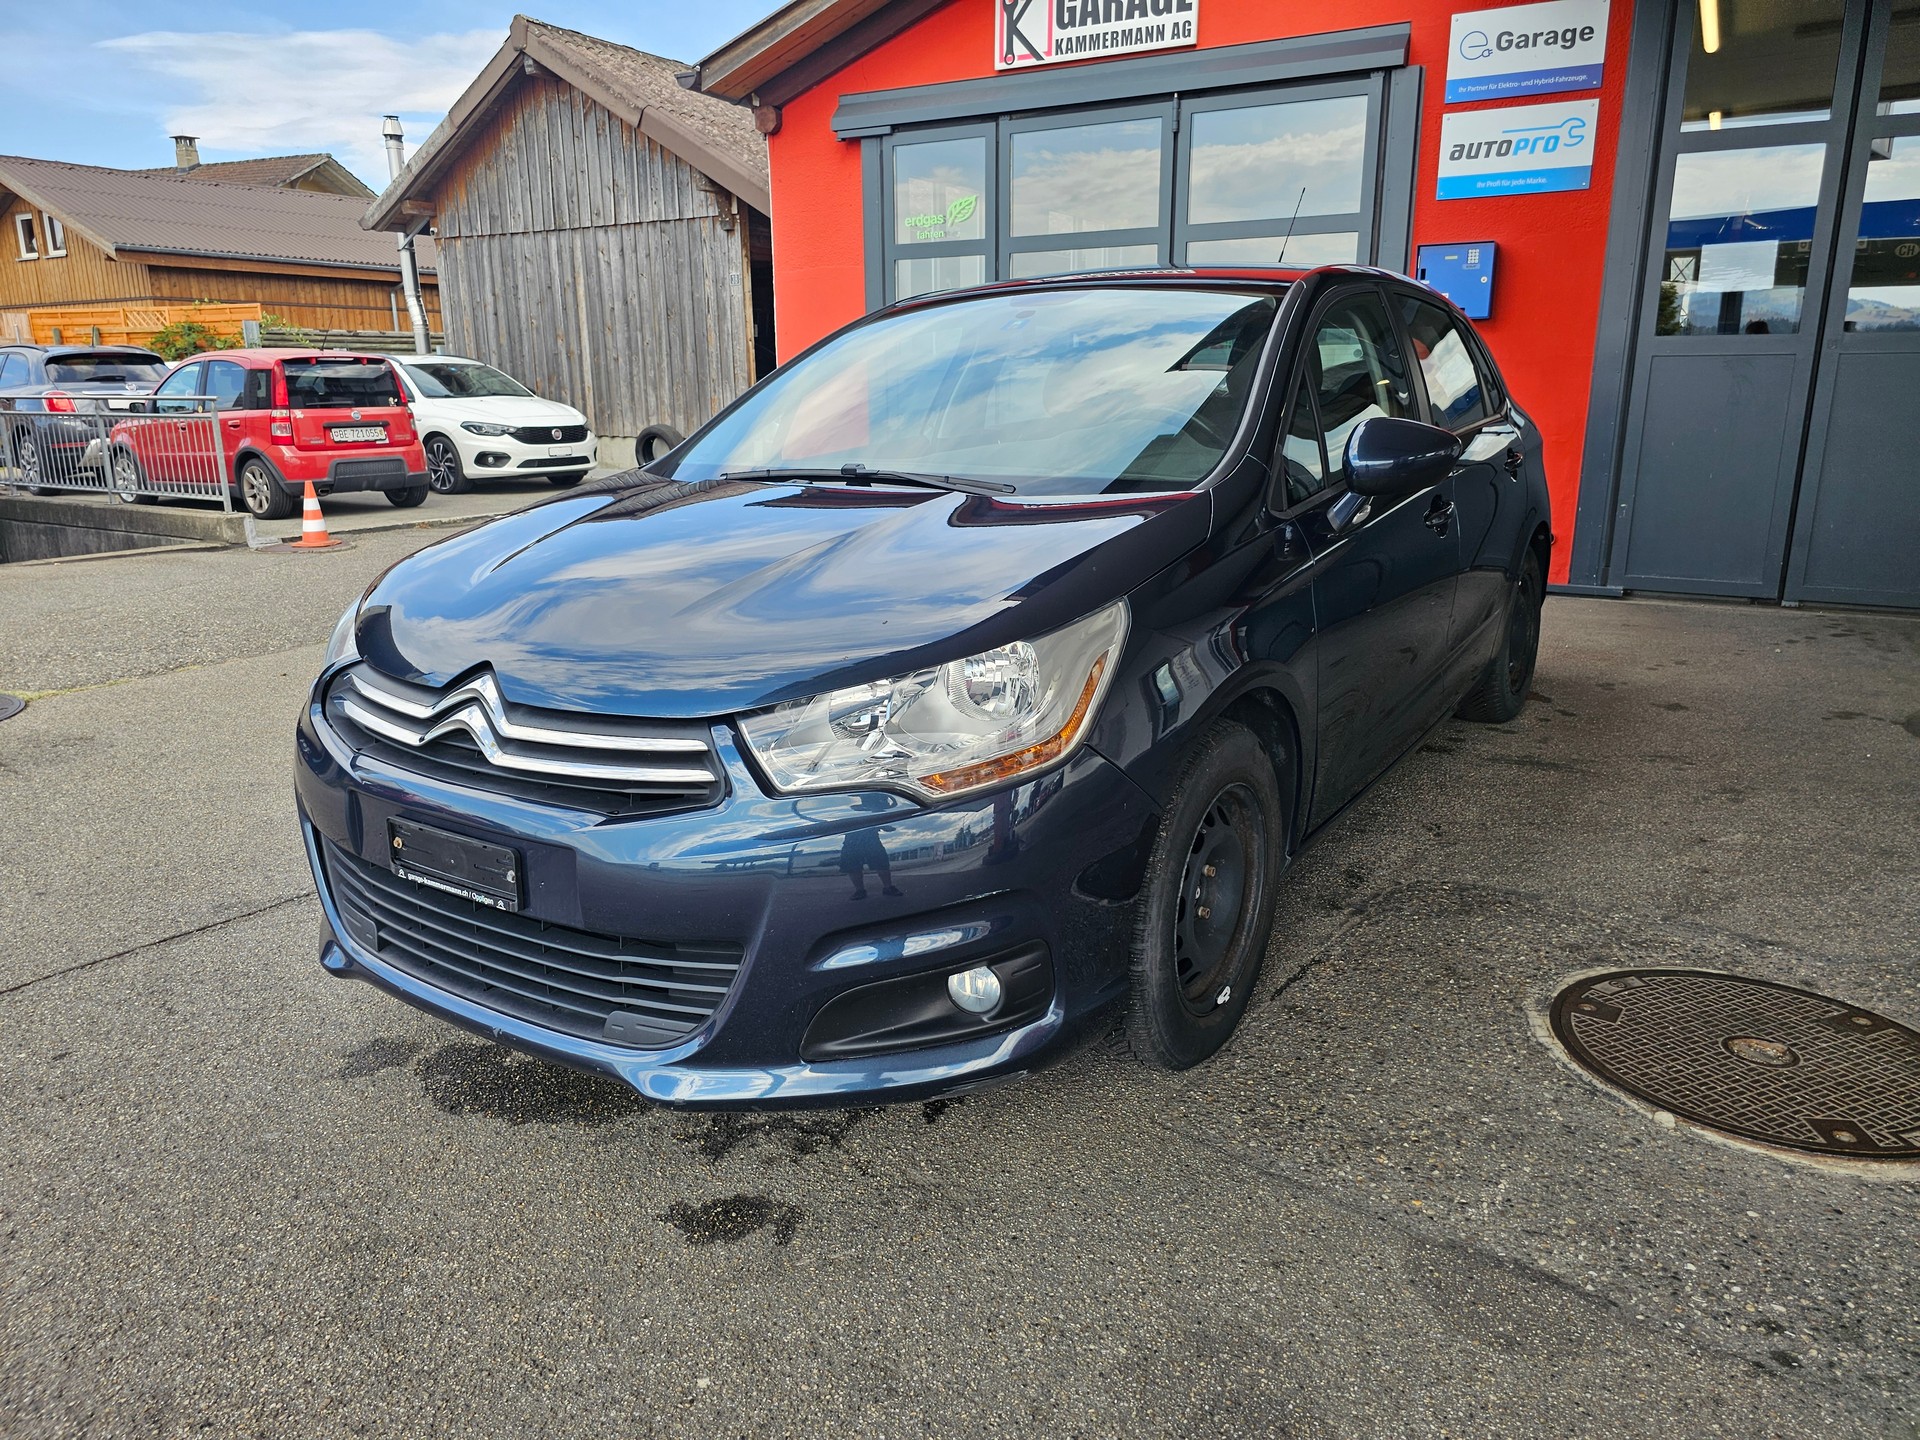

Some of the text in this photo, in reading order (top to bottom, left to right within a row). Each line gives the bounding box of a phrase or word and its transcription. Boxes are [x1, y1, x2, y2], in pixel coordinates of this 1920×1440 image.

[1055, 20, 1192, 56] KAMMERMANN AG
[1495, 25, 1595, 52] Garage
[1488, 83, 1498, 91] für
[1498, 81, 1520, 89] Elektro-
[1521, 79, 1533, 87] und
[1534, 74, 1588, 86] Hybrid-Fahrzeuge.
[1486, 180, 1501, 188] Profi
[1510, 178, 1526, 187] jede
[1526, 177, 1548, 185] Marke.
[904, 214, 945, 228] erdgas
[1898, 244, 1916, 256] CH
